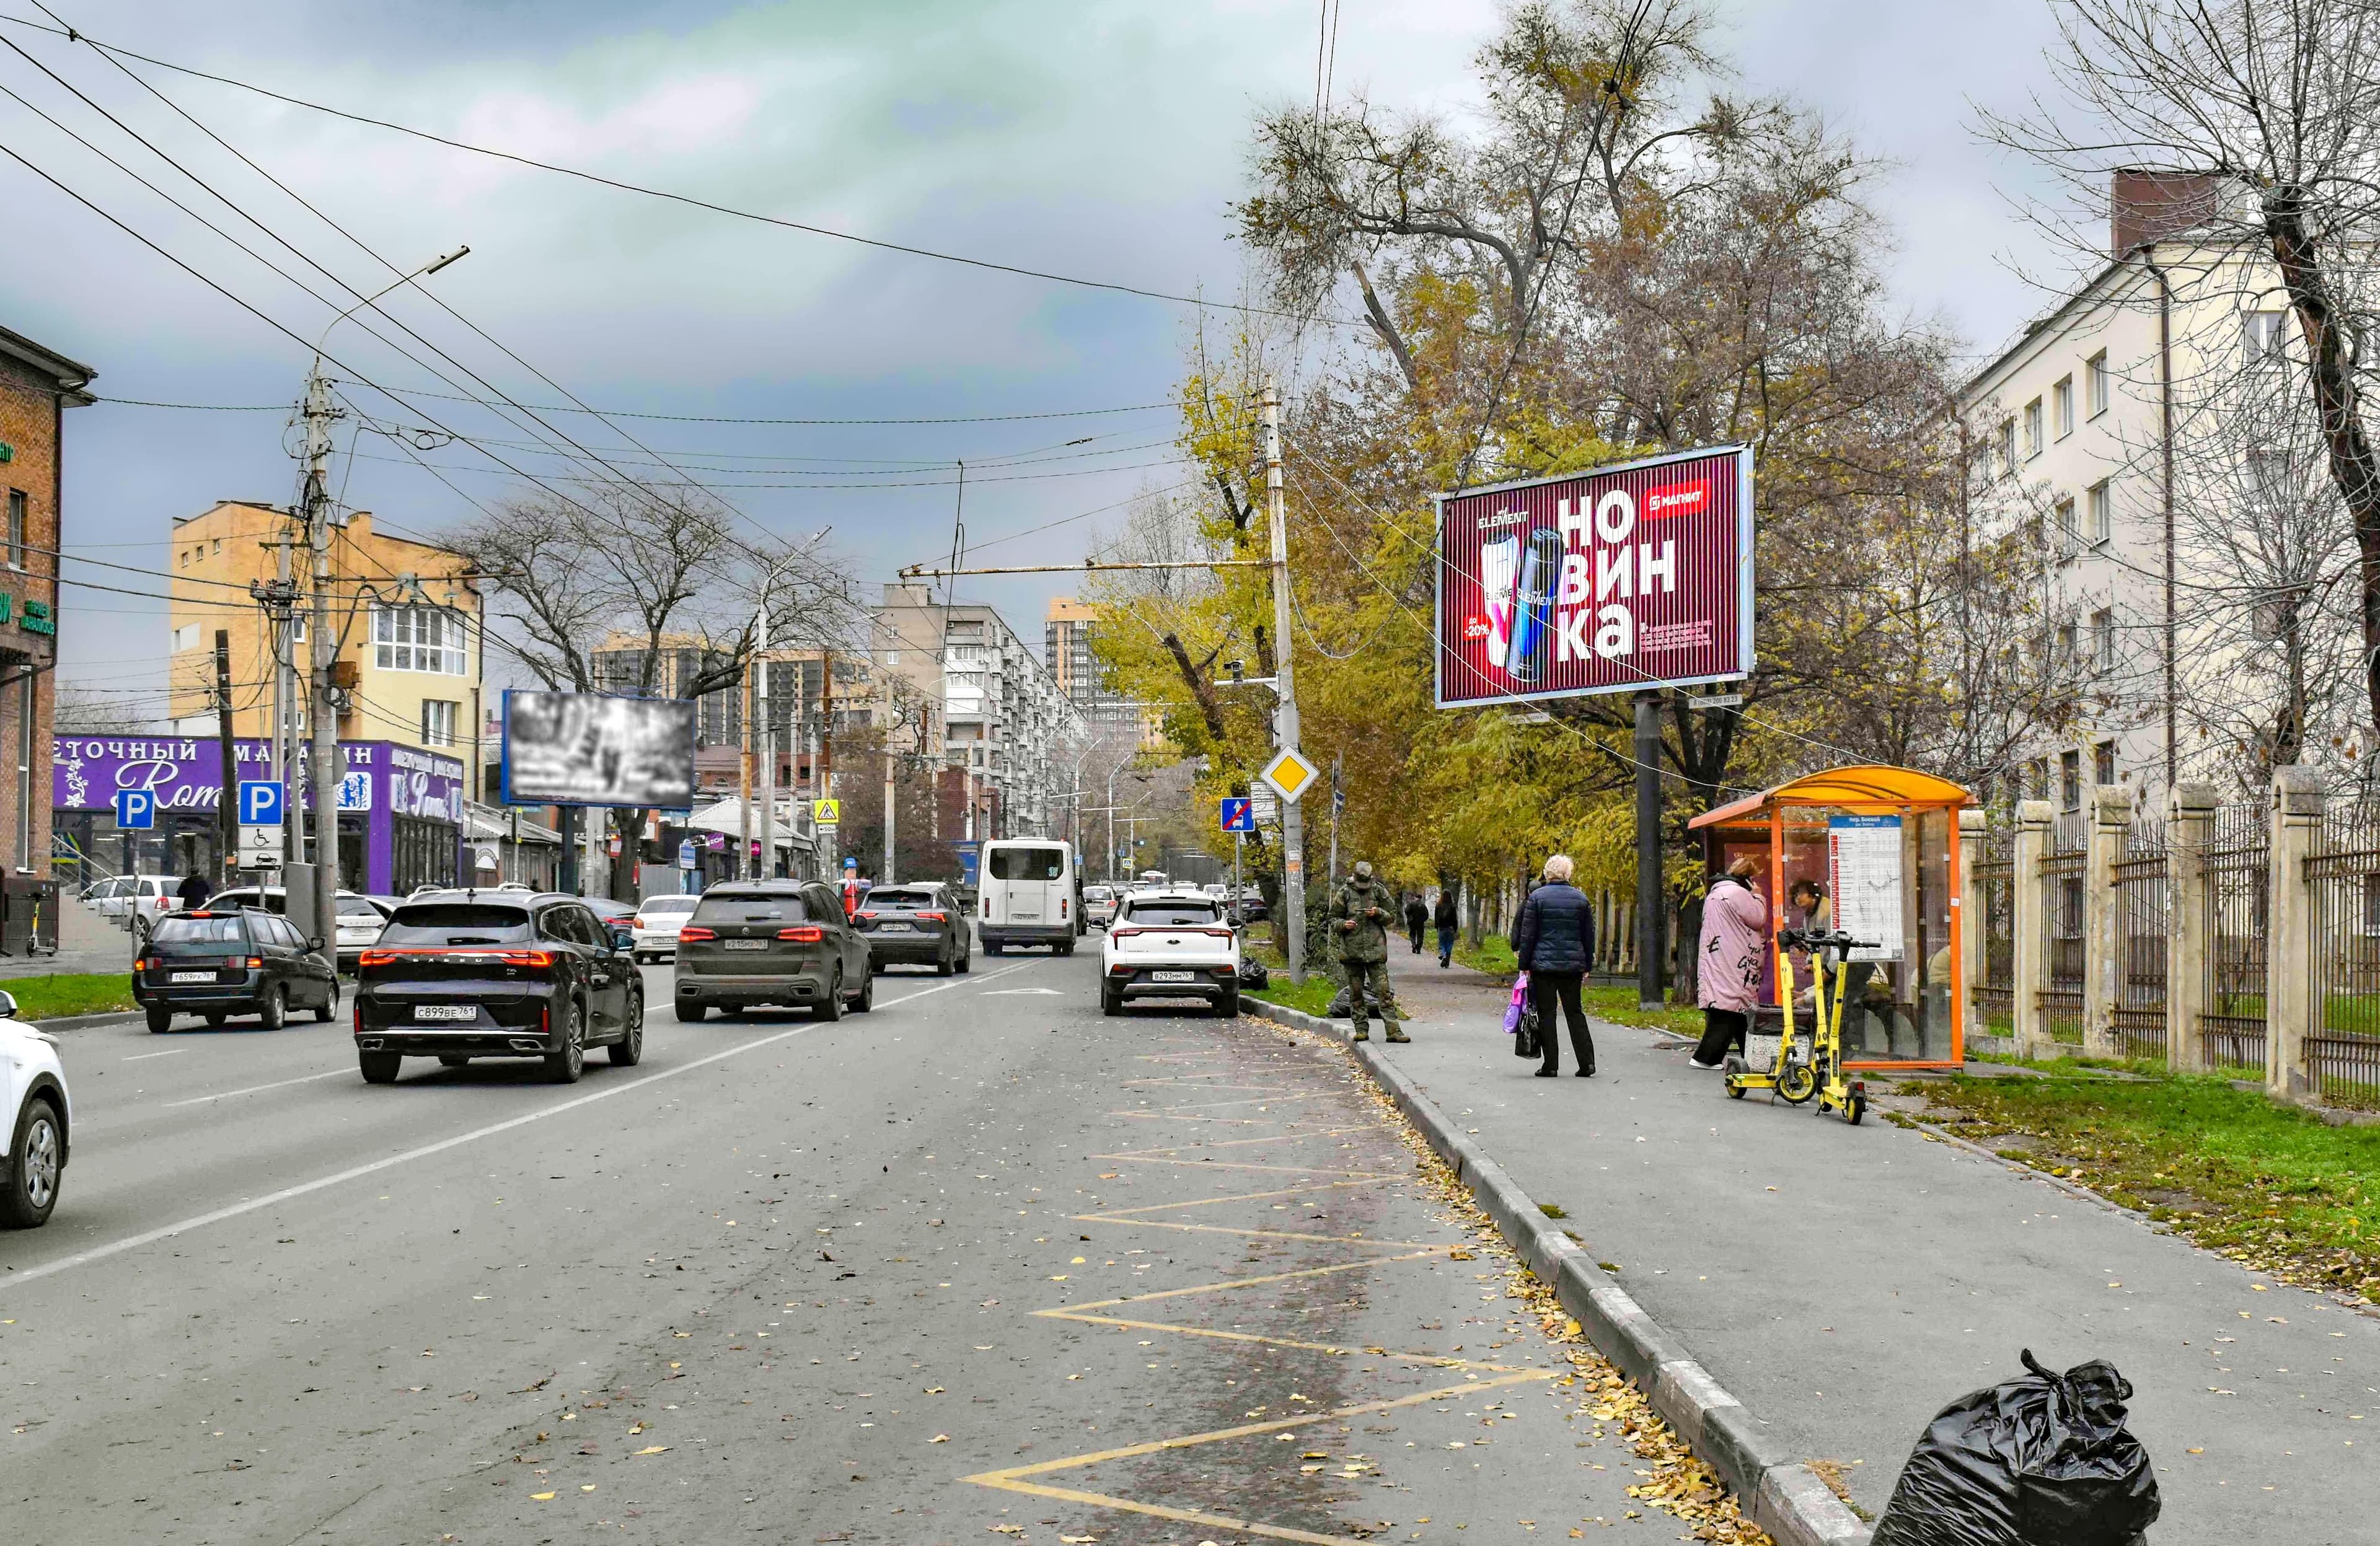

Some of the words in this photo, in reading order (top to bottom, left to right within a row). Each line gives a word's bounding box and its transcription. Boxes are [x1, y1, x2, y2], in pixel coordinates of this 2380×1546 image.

[1662, 491, 1701, 507] МАГНИТ
[1478, 511, 1528, 529] ELEMENT
[1464, 623, 1490, 636] -20%
[127, 794, 148, 824] P
[250, 786, 275, 821] P
